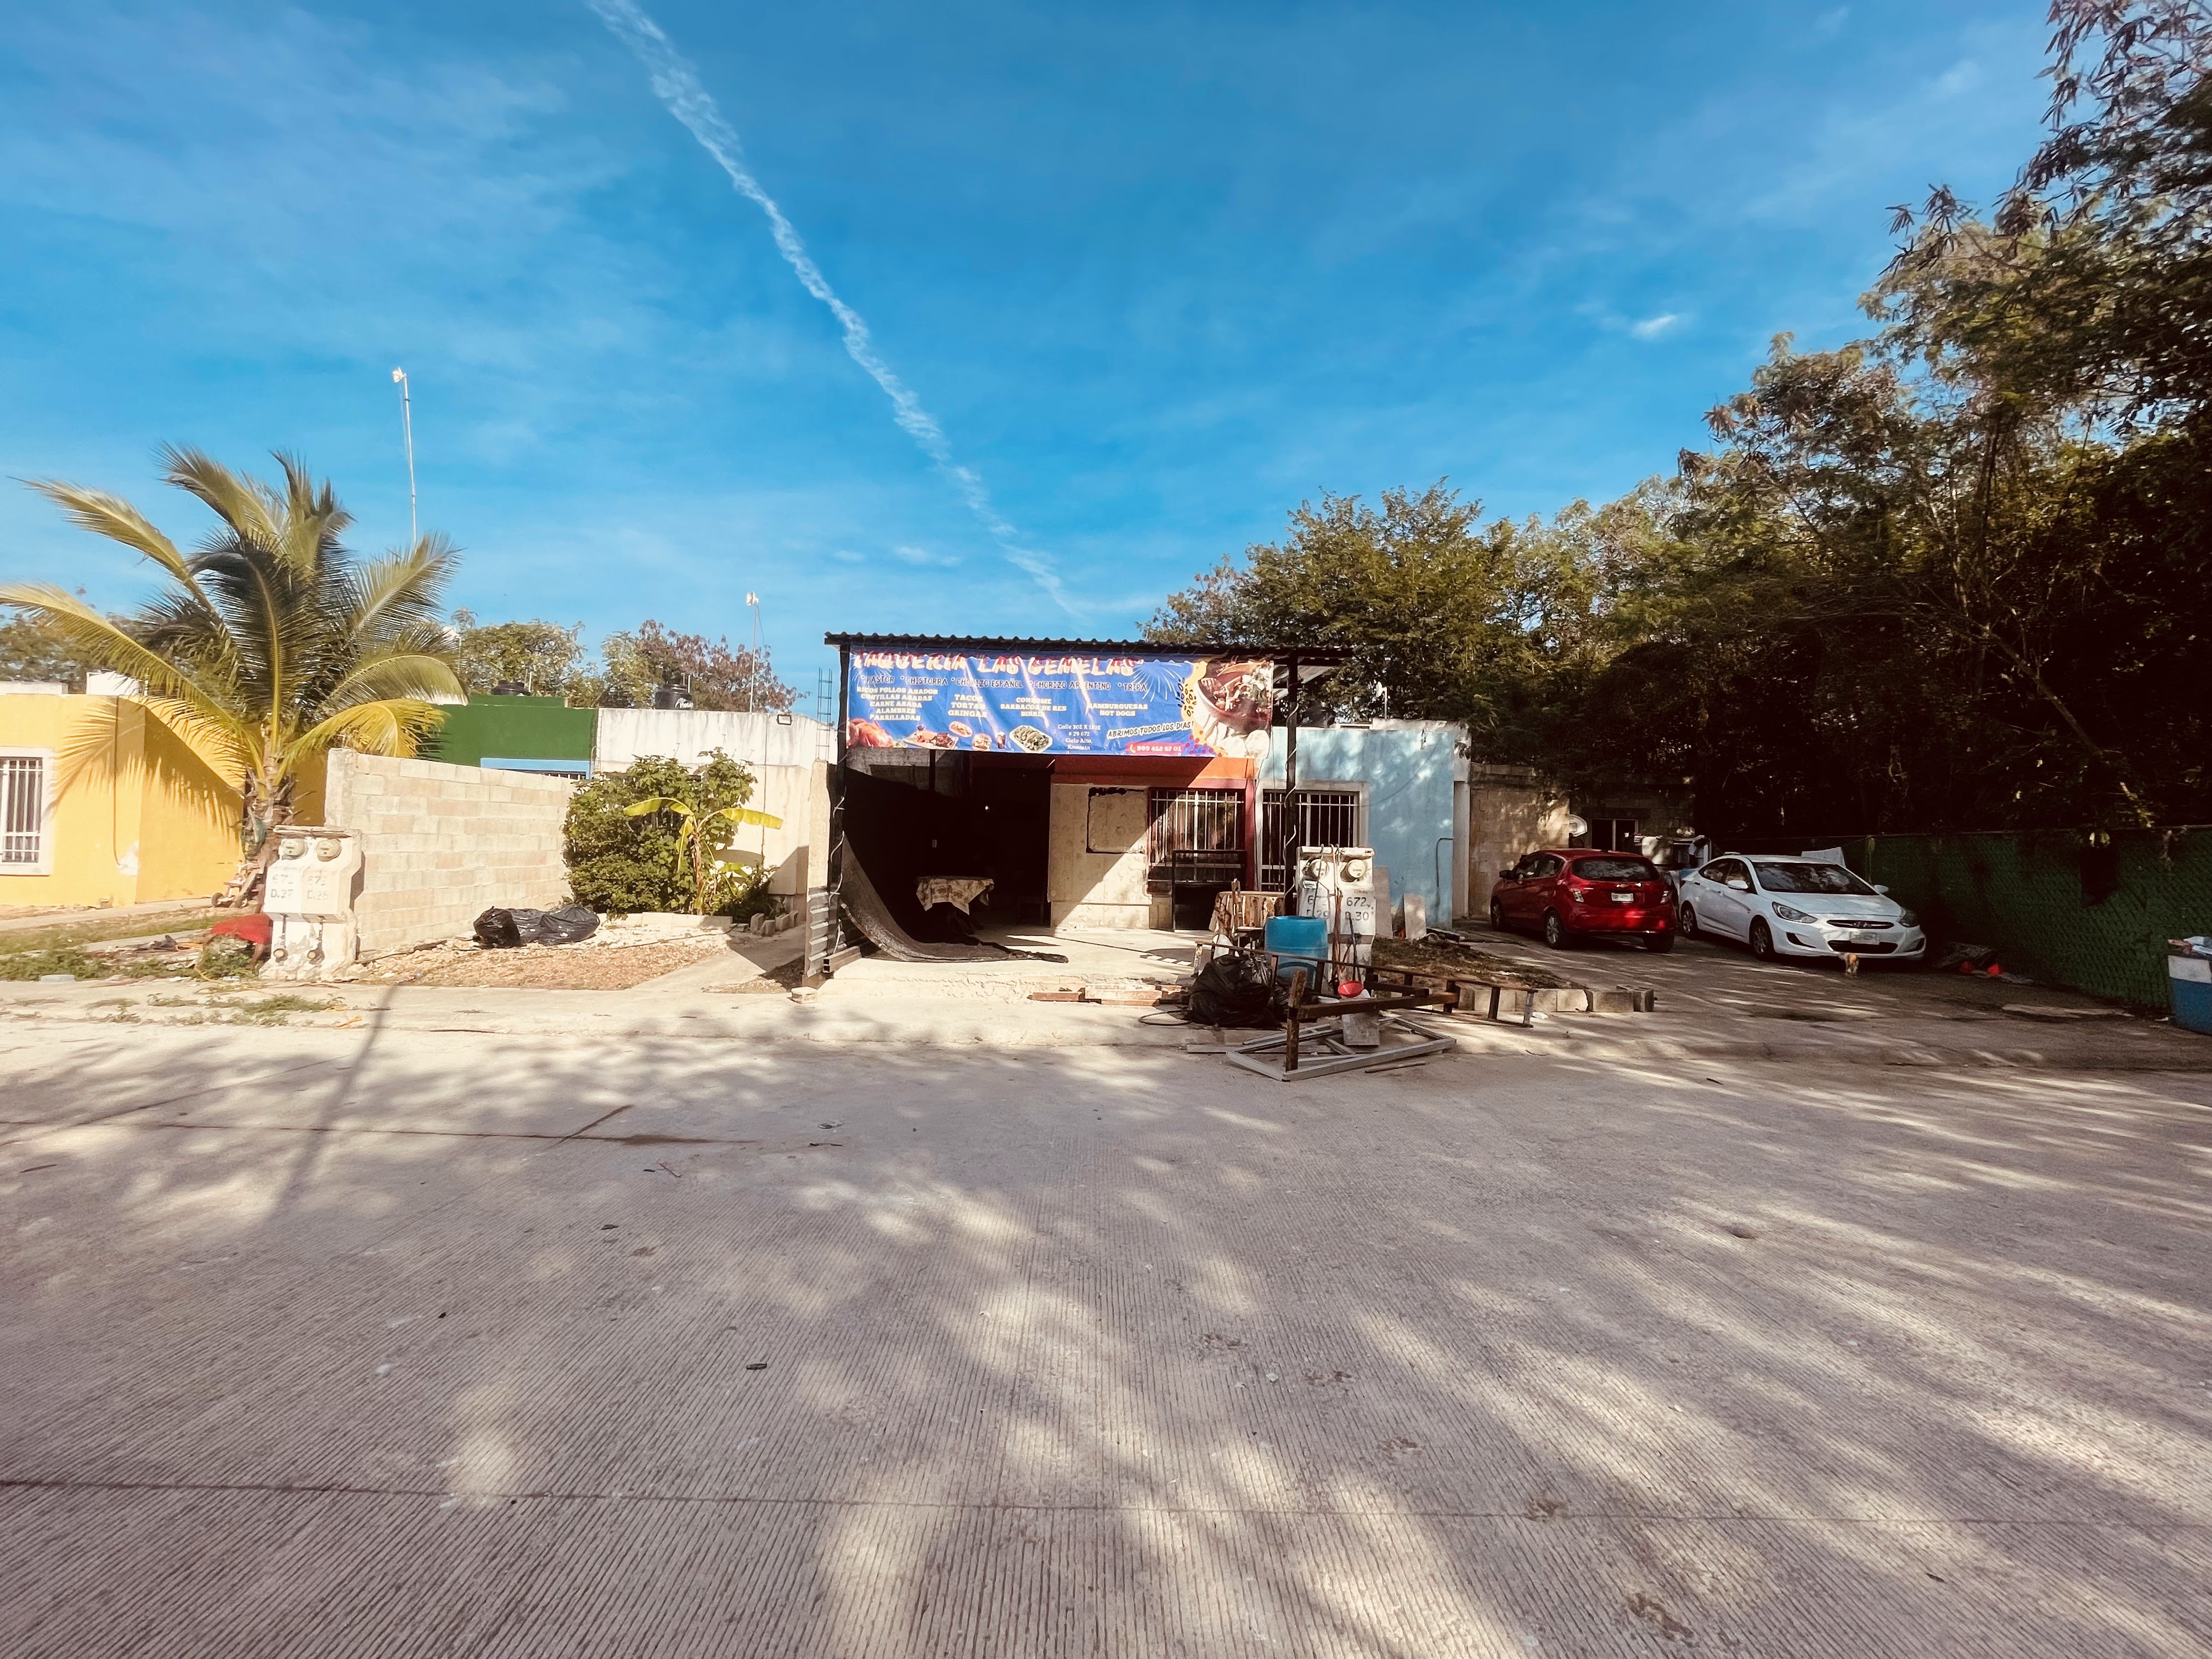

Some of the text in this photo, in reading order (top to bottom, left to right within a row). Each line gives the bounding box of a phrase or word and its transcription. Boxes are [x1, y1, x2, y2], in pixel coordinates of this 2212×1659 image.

[1070, 681, 1110, 690] ARENTINO
[954, 694, 983, 702] TACOS
[951, 702, 986, 710] TORTAS
[1108, 727, 1138, 737] ABRIMOS
[1140, 725, 1161, 733] TODOS
